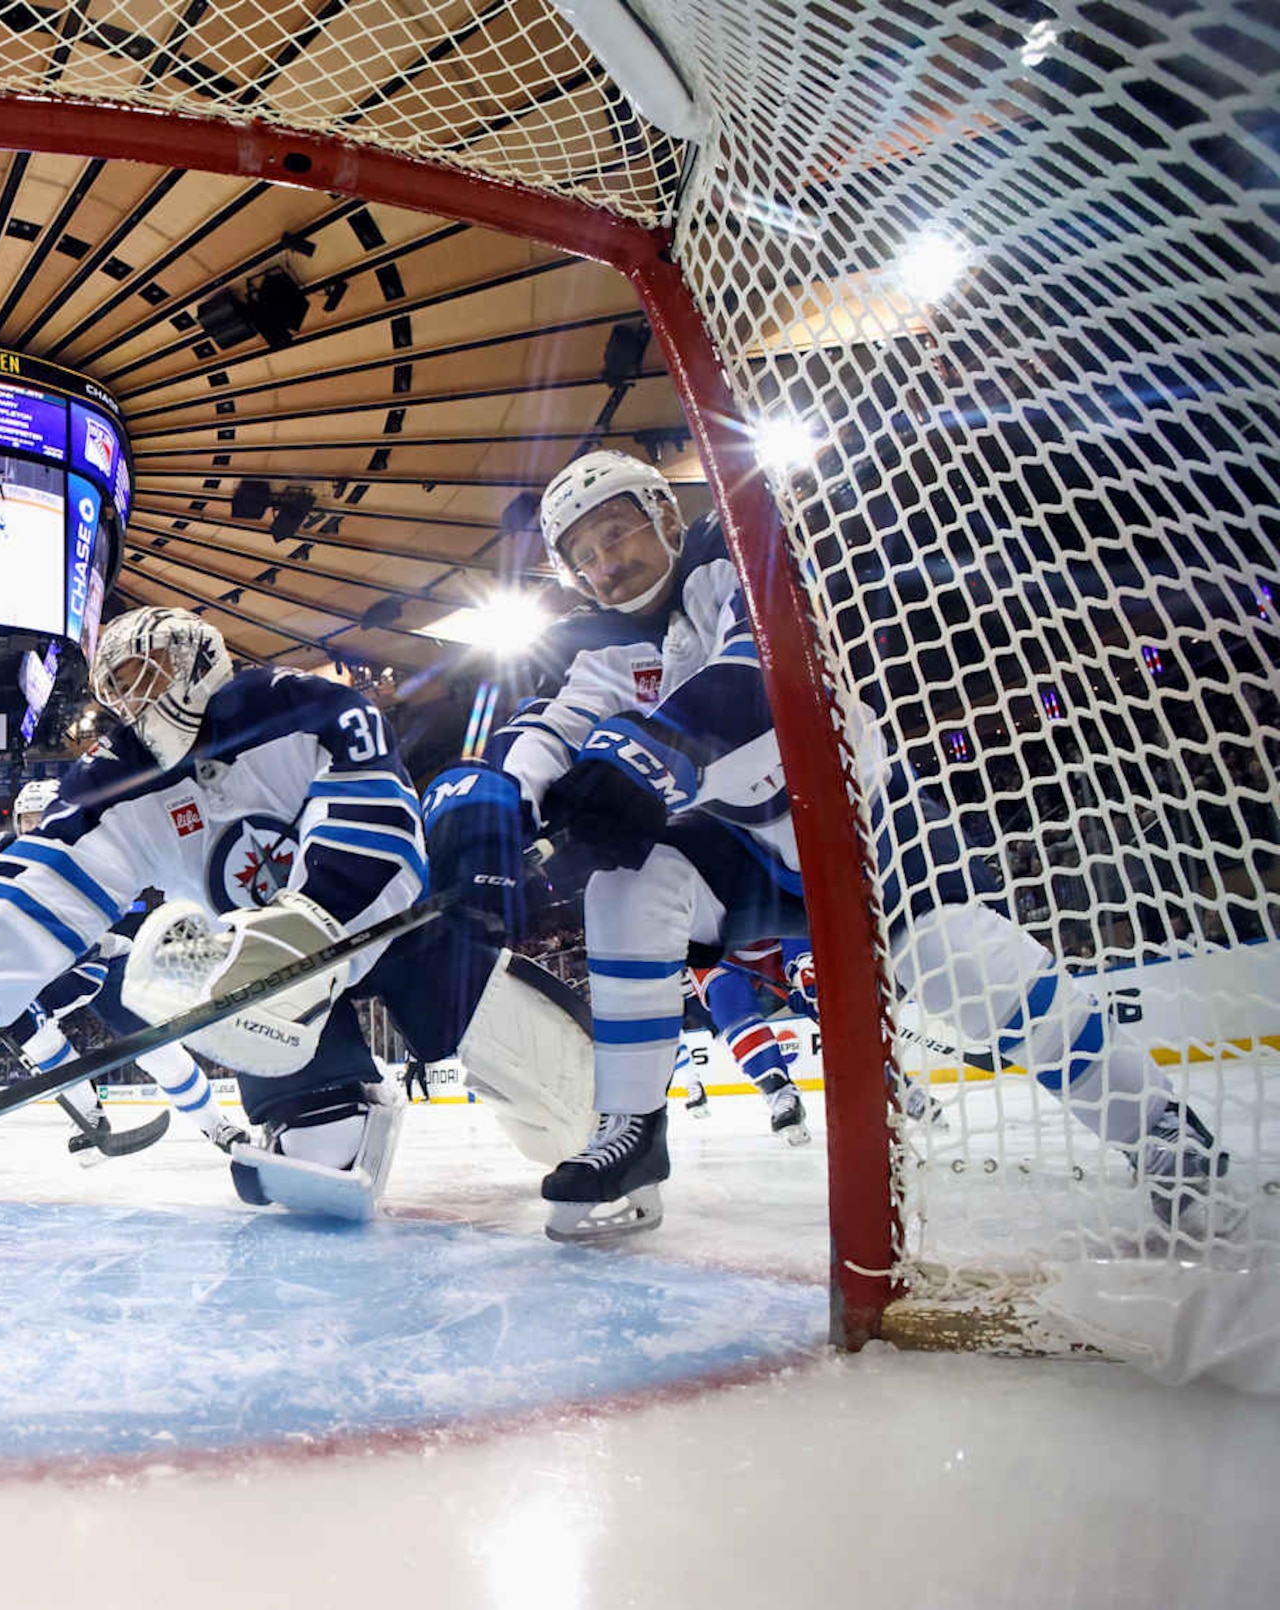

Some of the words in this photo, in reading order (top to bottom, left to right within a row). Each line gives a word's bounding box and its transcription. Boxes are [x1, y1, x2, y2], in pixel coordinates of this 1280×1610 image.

[70, 522, 92, 616] CHASE
[586, 730, 689, 806] CCM
[473, 874, 517, 888] CCM
